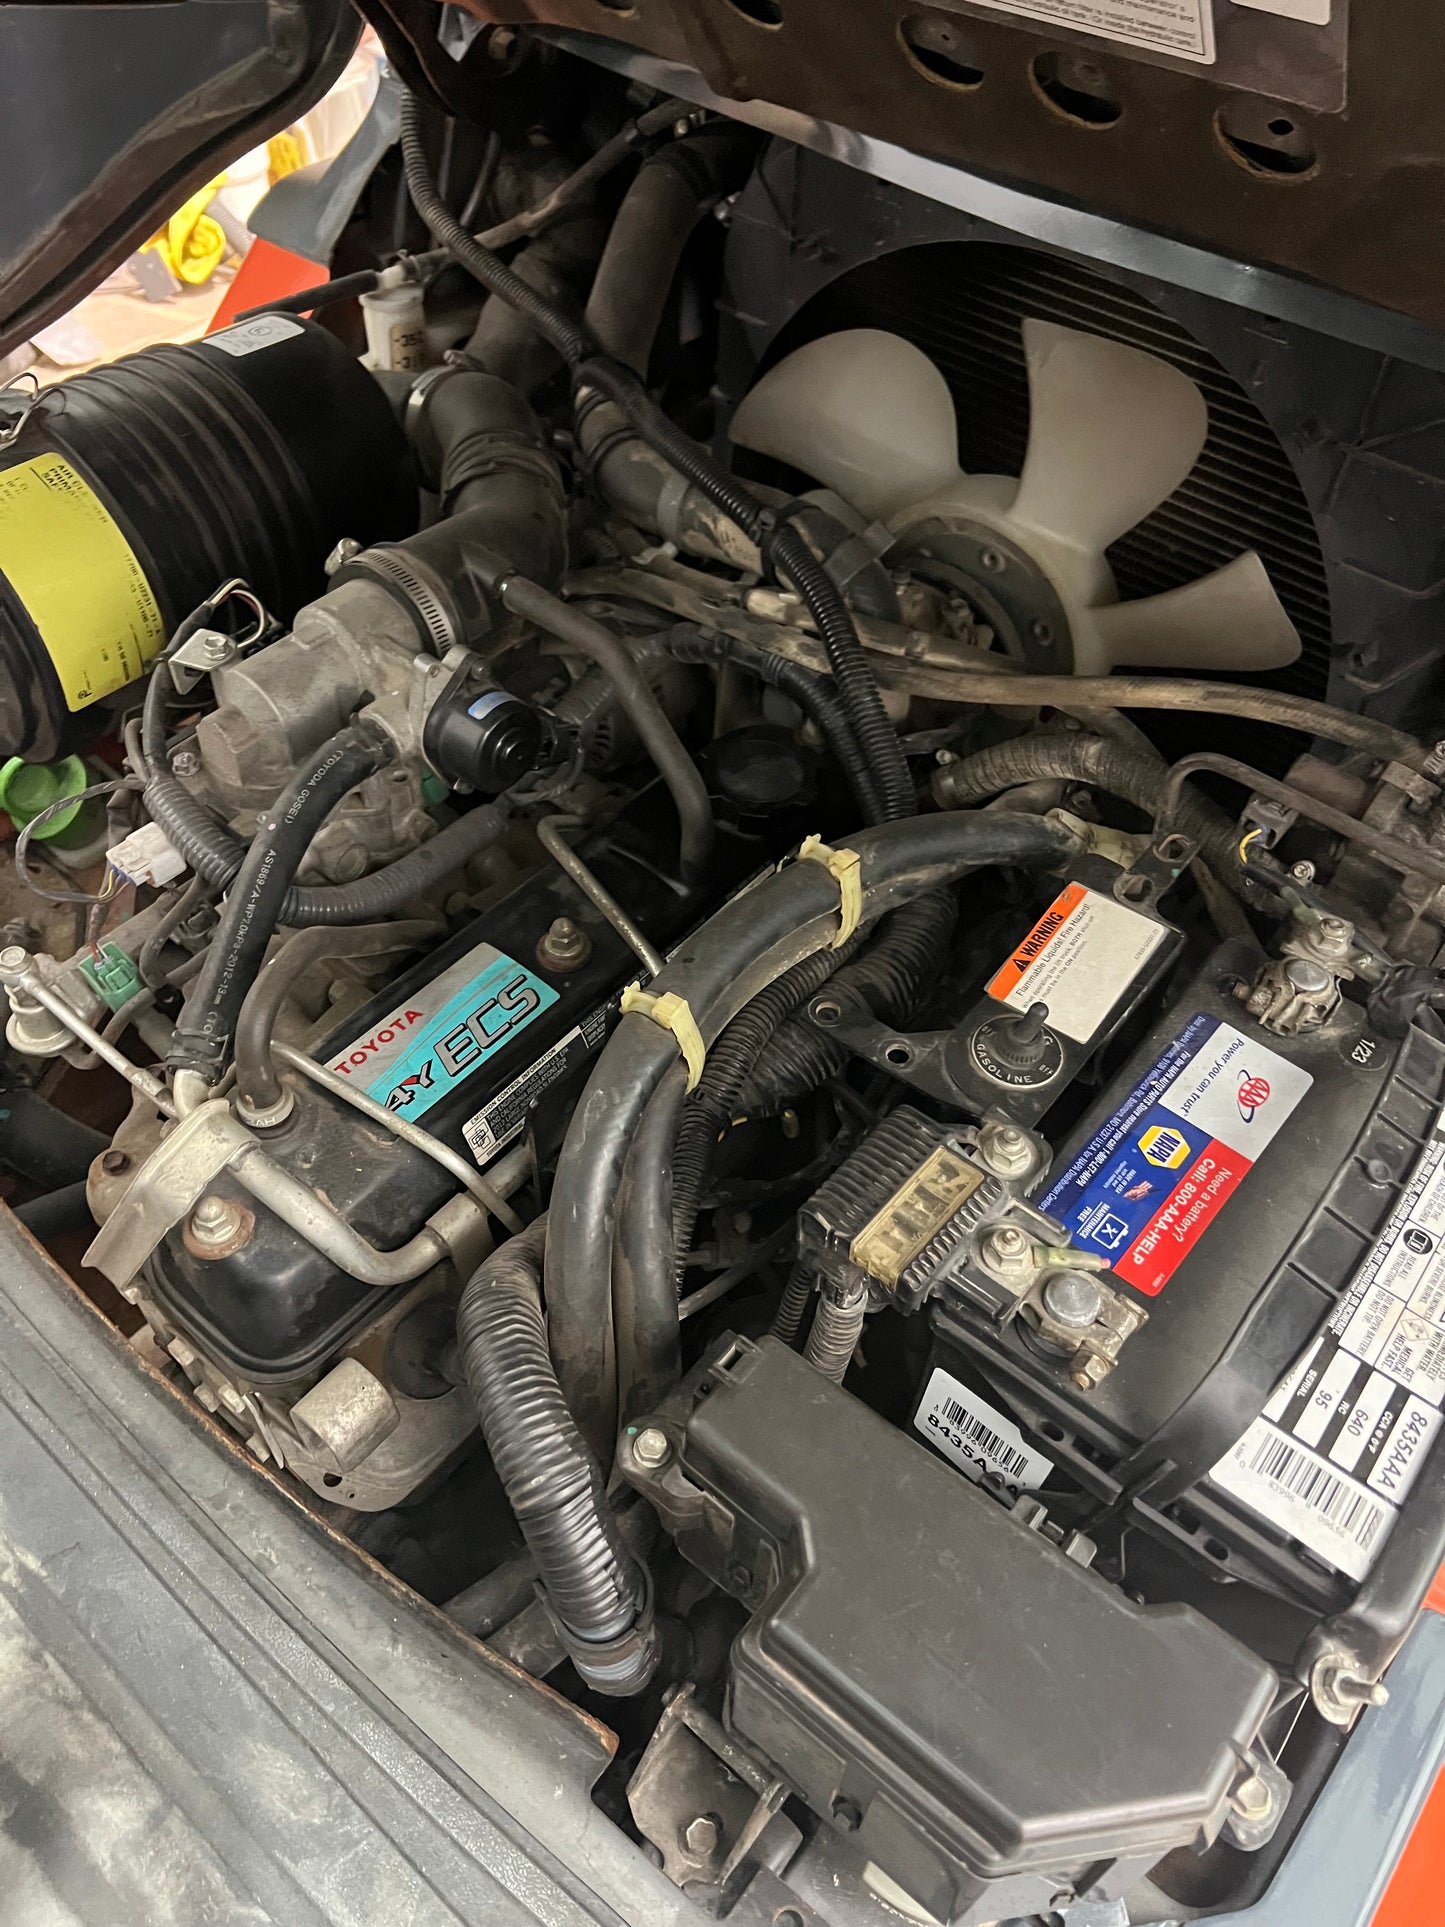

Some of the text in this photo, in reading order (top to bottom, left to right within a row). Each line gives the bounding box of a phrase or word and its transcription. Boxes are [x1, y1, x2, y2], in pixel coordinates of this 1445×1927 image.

[283, 749, 344, 825] (TOYODA GOSEI)
[1014, 901, 1090, 997] Flammable Liquids! Fire Hazard!
[1019, 909, 1064, 958] WARNING
[1068, 929, 1084, 948] BOTH
[1063, 956, 1075, 968] ON
[333, 1005, 424, 1076] TOYOTA
[431, 973, 541, 1077] ECS
[1177, 1028, 1194, 1045] NAPA
[976, 1042, 1033, 1084] GASOLINE
[1194, 1035, 1245, 1096] Power you can
[1351, 1039, 1376, 1063] 1/23
[469, 1099, 498, 1125] EMISSION
[495, 1077, 523, 1103] CONTROL
[519, 1047, 558, 1081] INFORMATION
[513, 1073, 540, 1097] COMPLIES
[1038, 1064, 1054, 1076] OFF
[498, 1091, 529, 1118] CALIFORNIA
[525, 1064, 558, 1095] REGULATIONS
[1073, 1049, 1191, 1189] For the NAPA AUTO PARTS Store nearest you call 1-800-LET-NAPA
[1096, 1122, 1115, 1141] 21237
[1107, 1114, 1121, 1128] MD
[1144, 1130, 1181, 1163] NAPA
[1070, 1154, 1087, 1173] NAPA
[1050, 1166, 1077, 1197] Distribution
[1036, 1190, 1057, 1213] Centers
[1075, 1204, 1092, 1223] FREE
[1128, 1154, 1216, 1265] Call: 800-AAA-HELP
[1170, 1164, 1232, 1242] Need a battery?
[1077, 1201, 1110, 1240] MAINTENANCE
[1370, 1250, 1385, 1266] NOT
[1396, 1253, 1417, 1280] READ ALL
[1351, 1261, 1379, 1299] DISASSEMBLE
[1359, 1288, 1386, 1325] DO NOT TIP.
[1354, 1294, 1395, 1357] DO NOT OPEN BATTERY.
[1426, 1329, 1444, 1350] WITH
[1379, 1331, 1407, 1370] HELP FAST.
[1389, 1344, 1413, 1377] MEDICAL
[1414, 1346, 1435, 1374] WATER.
[1294, 1367, 1319, 1400] SERIAL
[1400, 1366, 1416, 1383] GET
[1312, 1388, 1334, 1410] 95
[1335, 1399, 1351, 1416] RC
[1343, 1406, 1370, 1438] 640
[1372, 1427, 1385, 1440] @
[1376, 1409, 1394, 1431] CCA
[926, 1415, 1016, 1496] 8435AA
[1374, 1411, 1428, 1488] 8435AAA
